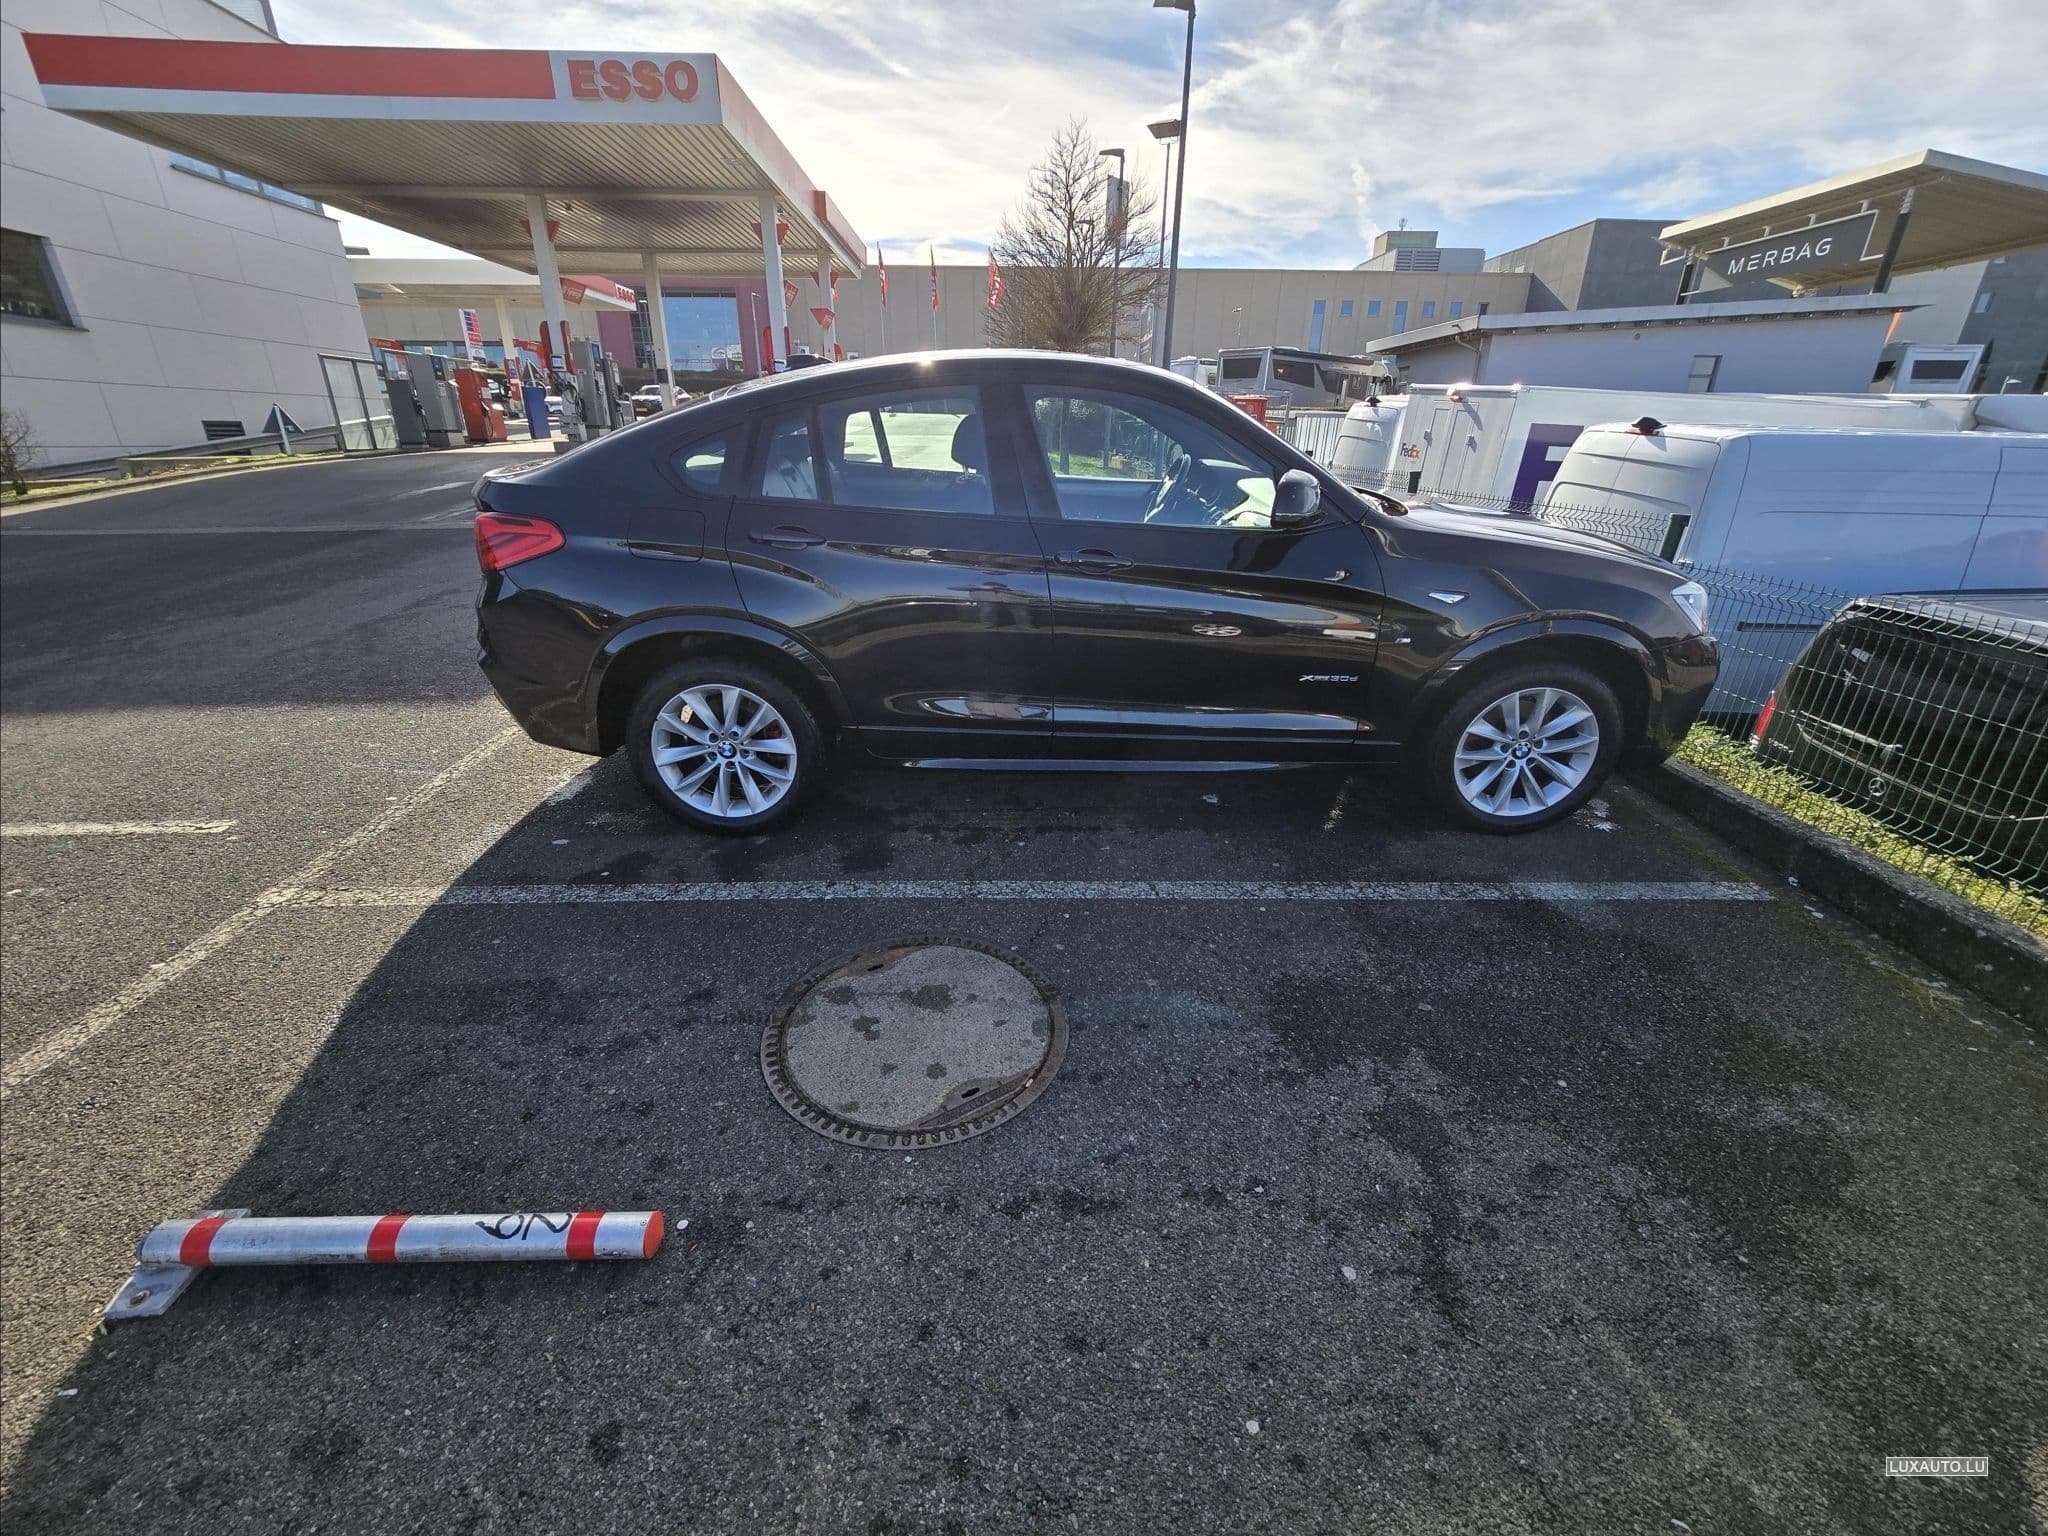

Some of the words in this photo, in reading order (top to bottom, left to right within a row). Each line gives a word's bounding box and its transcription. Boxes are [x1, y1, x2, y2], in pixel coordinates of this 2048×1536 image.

[567, 59, 699, 102] ESSO
[1727, 237, 1833, 275] MERBAG
[1400, 442, 1420, 459] FedEx
